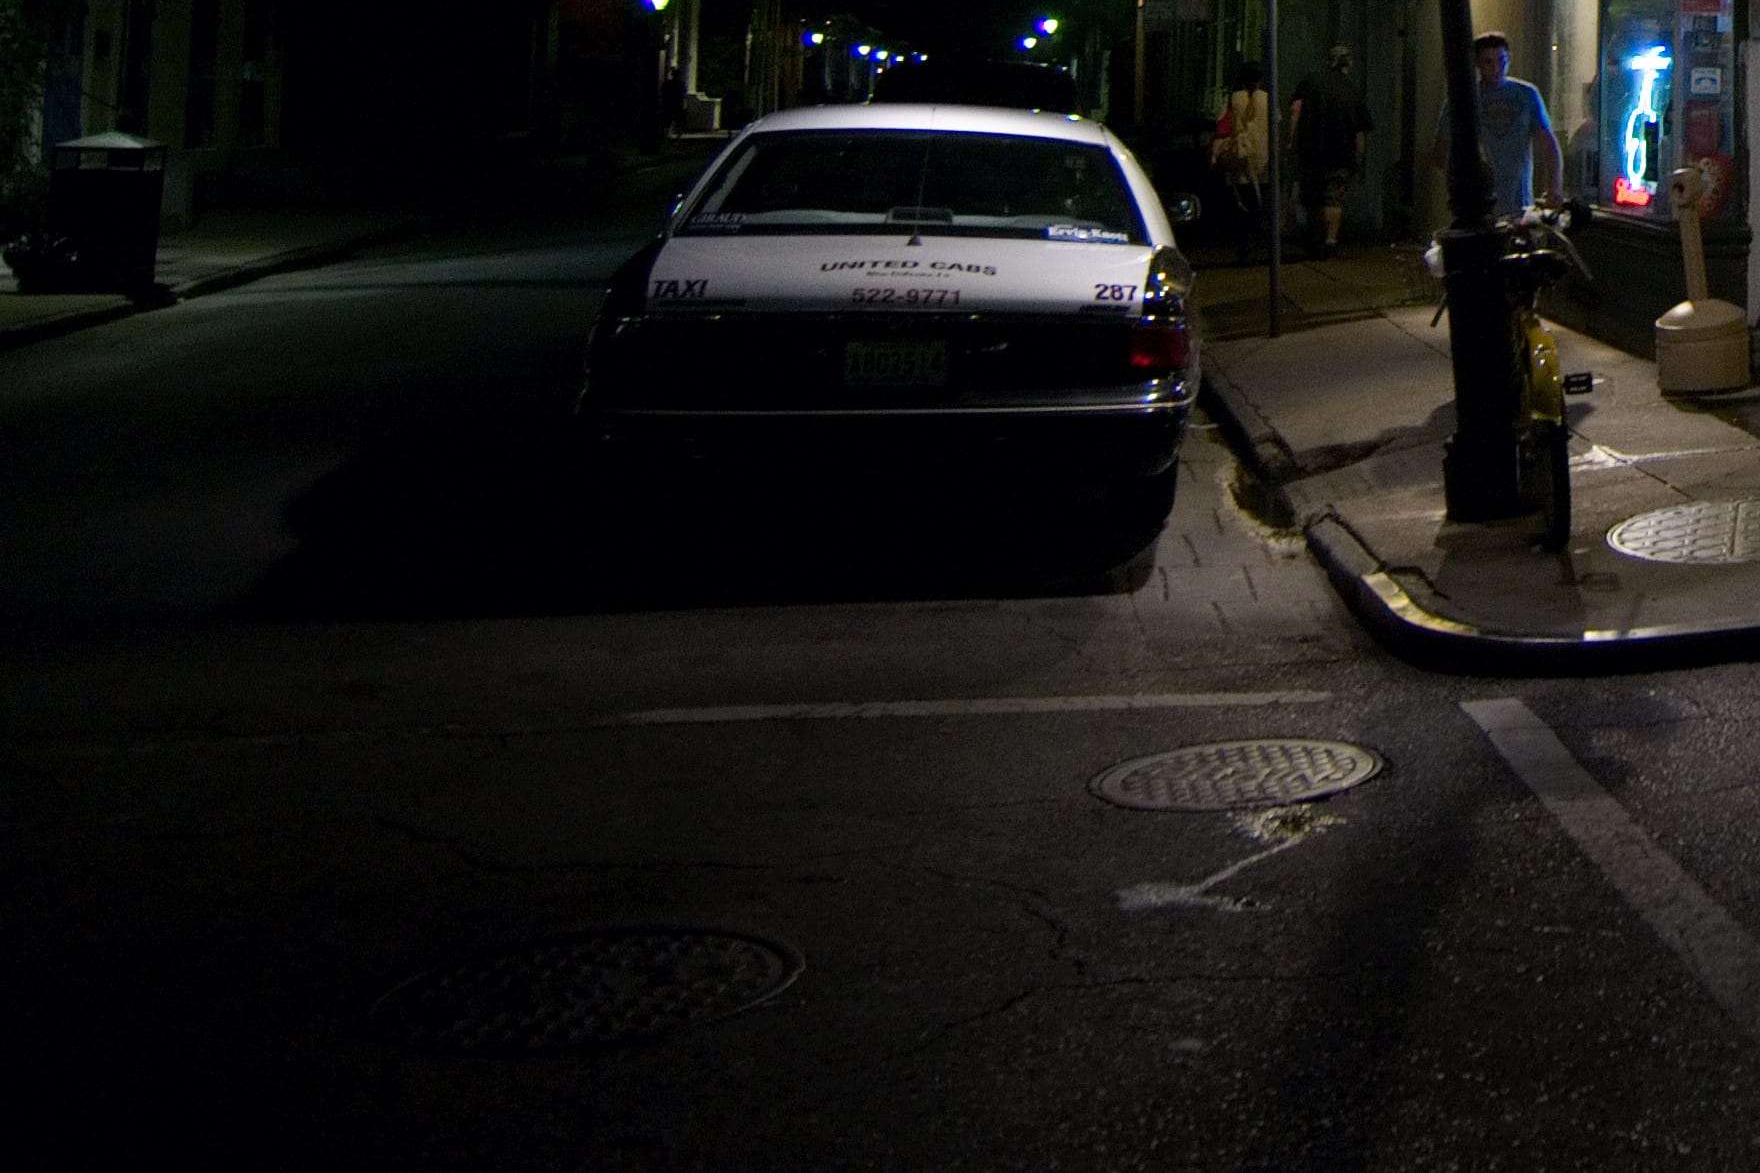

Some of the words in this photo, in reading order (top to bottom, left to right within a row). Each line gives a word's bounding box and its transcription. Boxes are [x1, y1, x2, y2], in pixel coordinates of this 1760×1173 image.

[820, 260, 919, 272] UNITED
[930, 262, 996, 276] CABS
[652, 279, 708, 299] TAXI
[852, 288, 962, 305] 522-9771
[1094, 283, 1138, 306] 287
